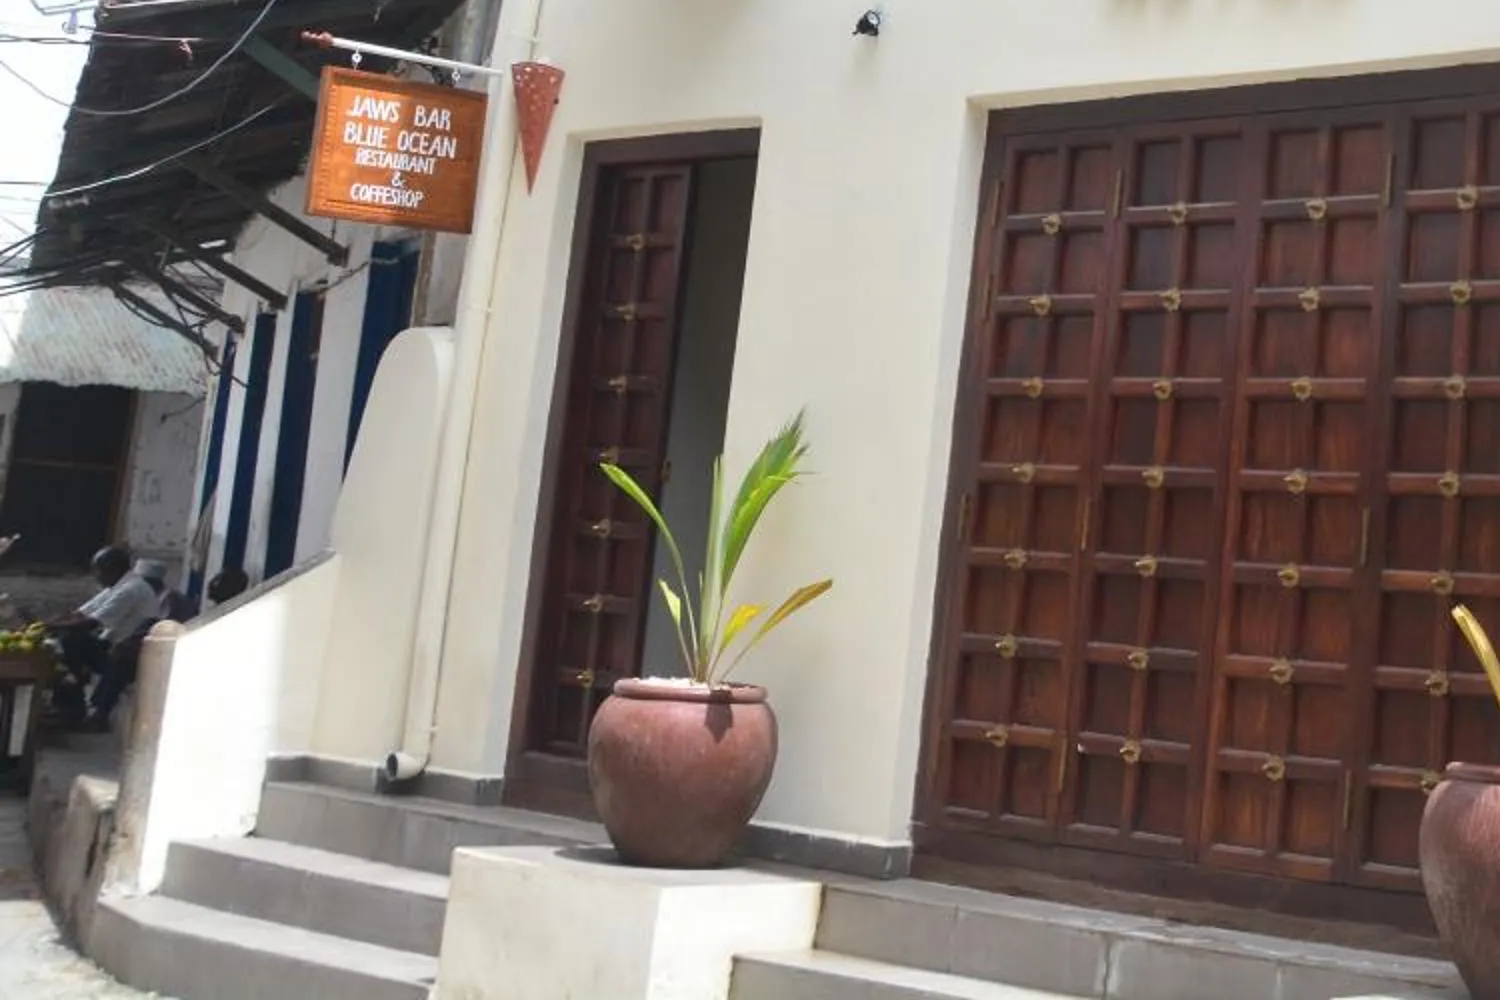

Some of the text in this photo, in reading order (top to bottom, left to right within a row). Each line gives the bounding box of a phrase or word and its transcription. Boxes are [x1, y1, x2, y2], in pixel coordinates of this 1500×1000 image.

[346, 95, 452, 131] JAWS BAR
[343, 120, 457, 159] BLUE OCEAN
[355, 147, 437, 175] RESTAURANT
[391, 170, 407, 188] &
[350, 183, 425, 209] COFFESHOP
